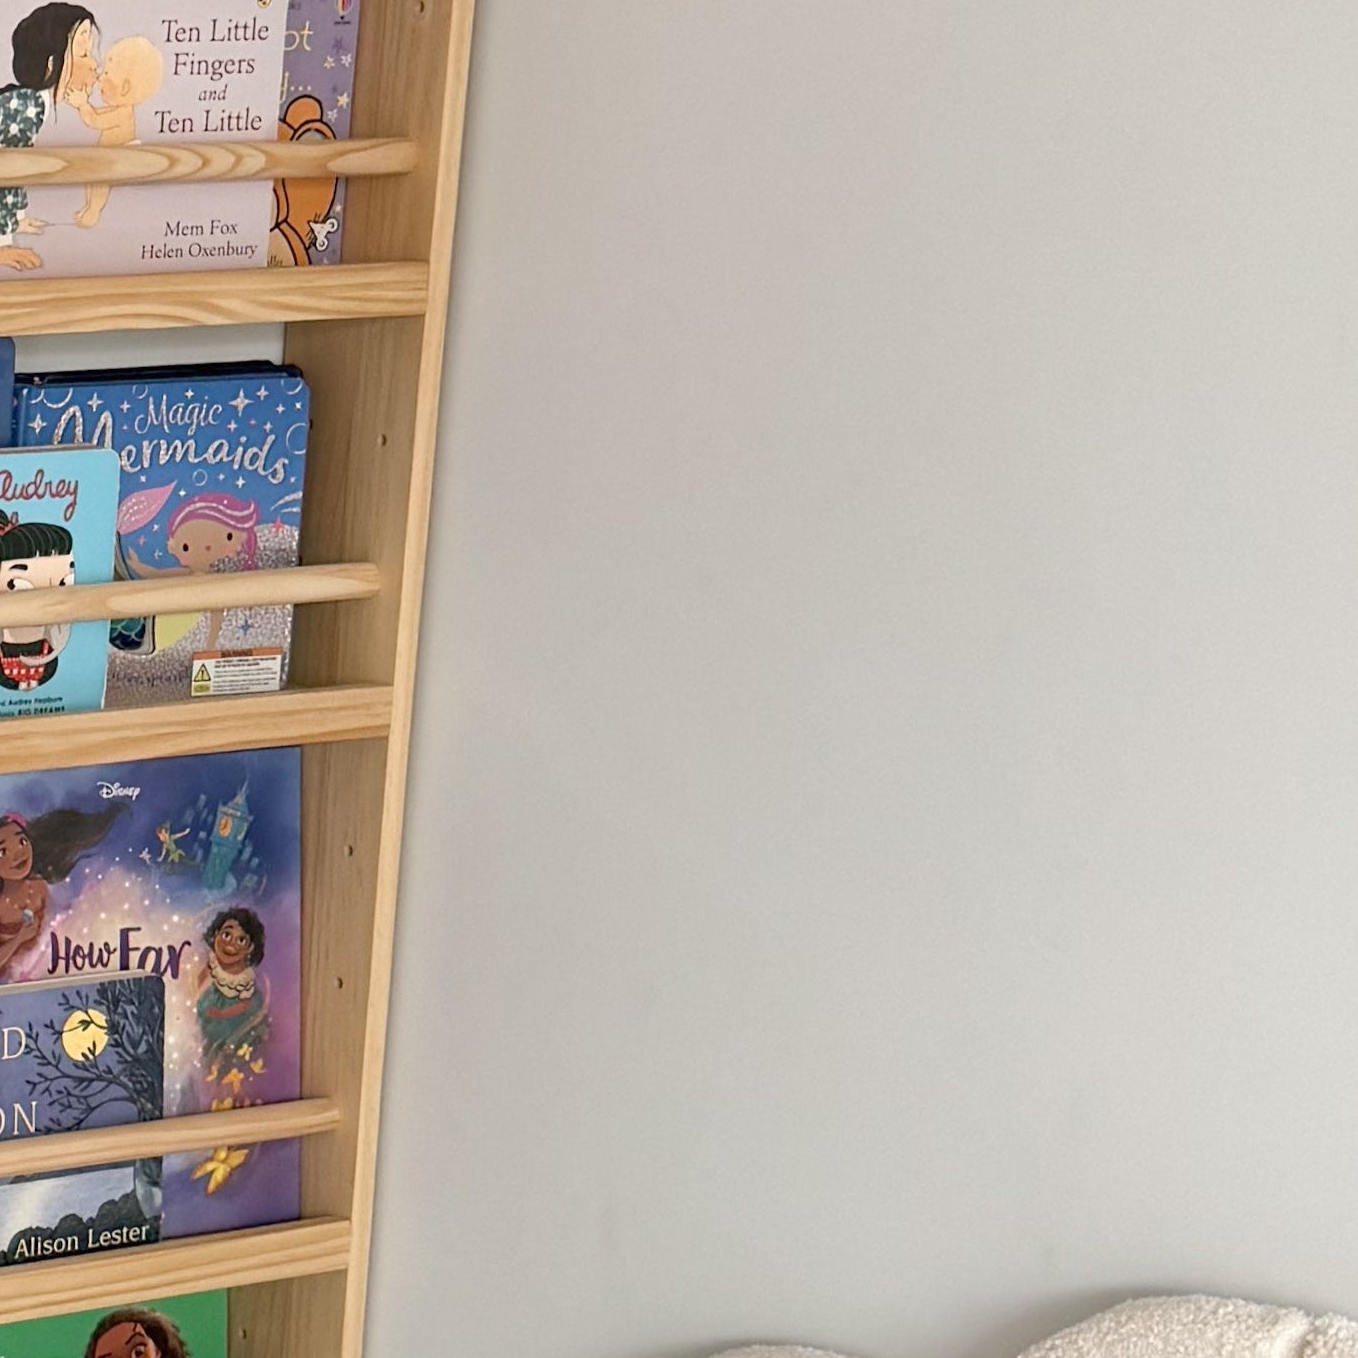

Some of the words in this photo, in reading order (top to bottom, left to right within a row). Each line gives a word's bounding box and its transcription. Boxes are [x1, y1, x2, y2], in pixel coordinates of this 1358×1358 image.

[162, 20, 202, 43] Ten
[210, 17, 269, 43] Little
[173, 54, 255, 81] Fingers
[198, 84, 227, 101] and
[155, 109, 194, 134] Ten
[203, 108, 263, 133] Little
[164, 220, 204, 237] Mem
[210, 220, 238, 237] Fox
[141, 243, 185, 260] Helen
[188, 241, 258, 262] Oxenbury
[15, 1234, 79, 1260] Alison
[87, 1221, 150, 1248] Lester
